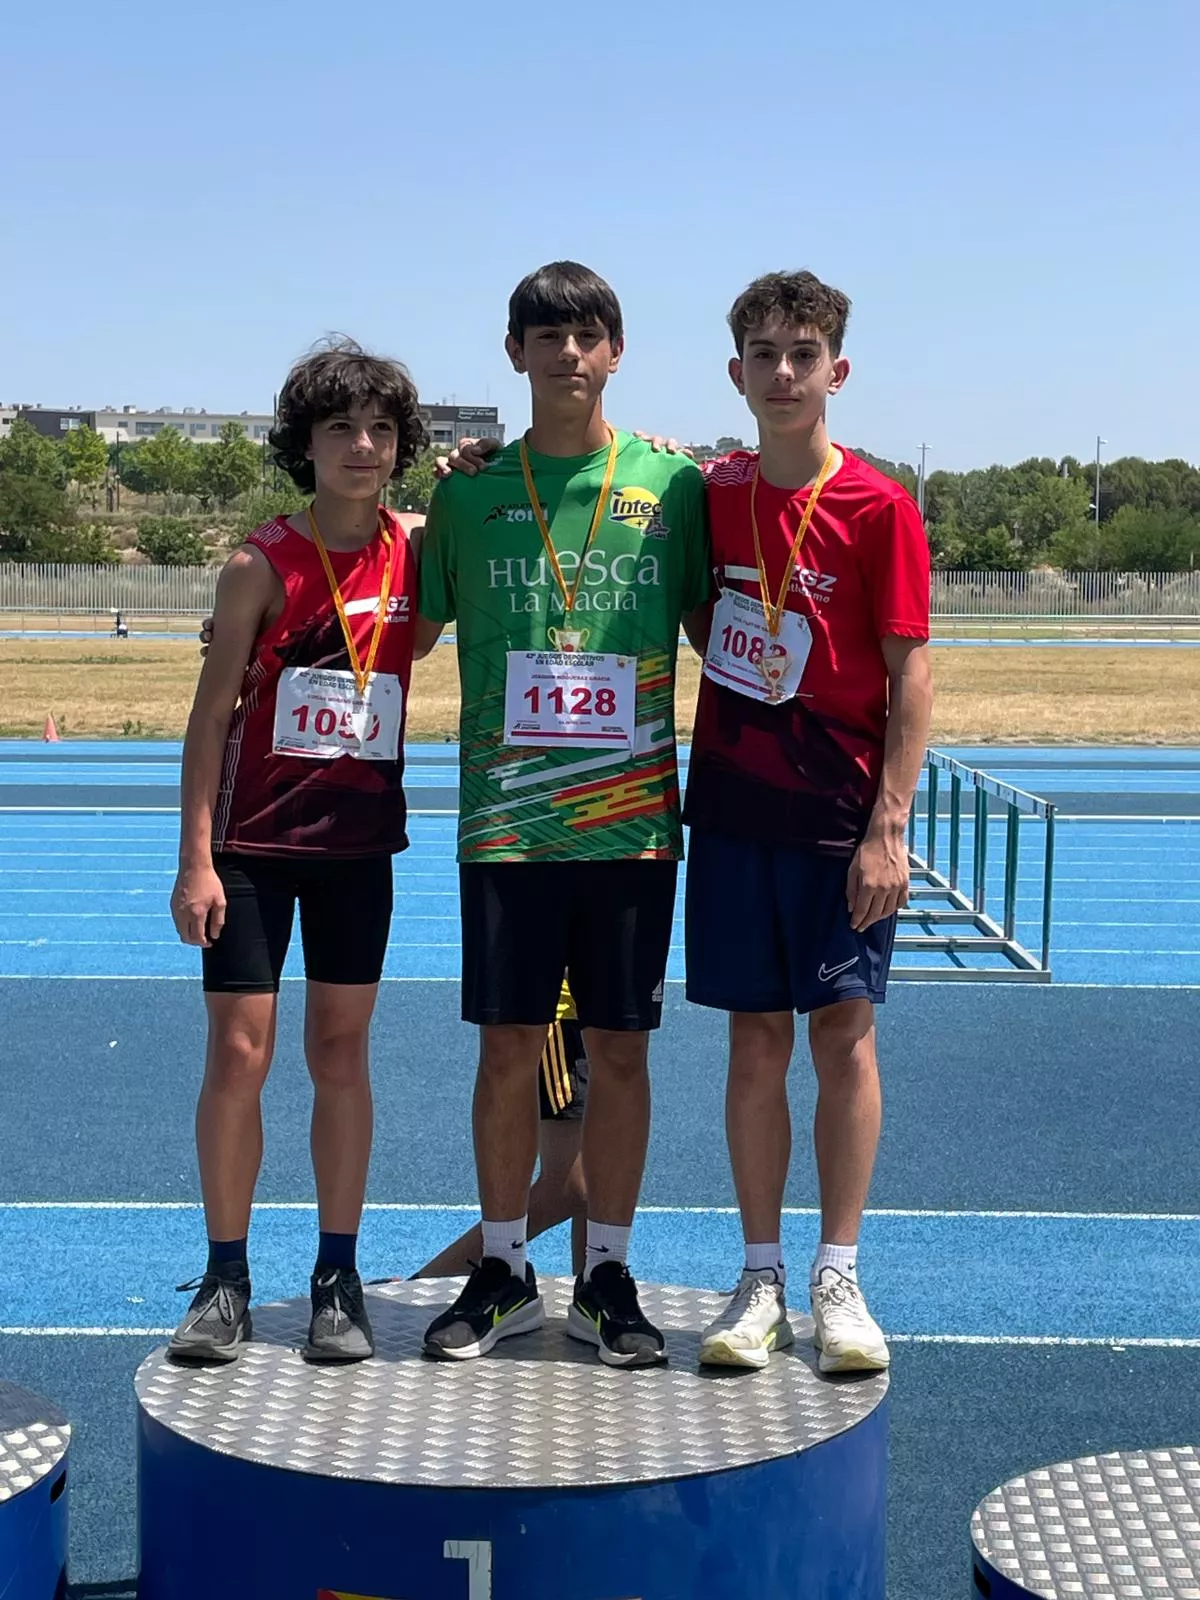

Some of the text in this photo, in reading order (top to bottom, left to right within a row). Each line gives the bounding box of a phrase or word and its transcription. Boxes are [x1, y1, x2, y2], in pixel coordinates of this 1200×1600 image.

[510, 592, 540, 613] La
[563, 654, 605, 662] DEPORTIVOS
[524, 686, 616, 716] 1128
